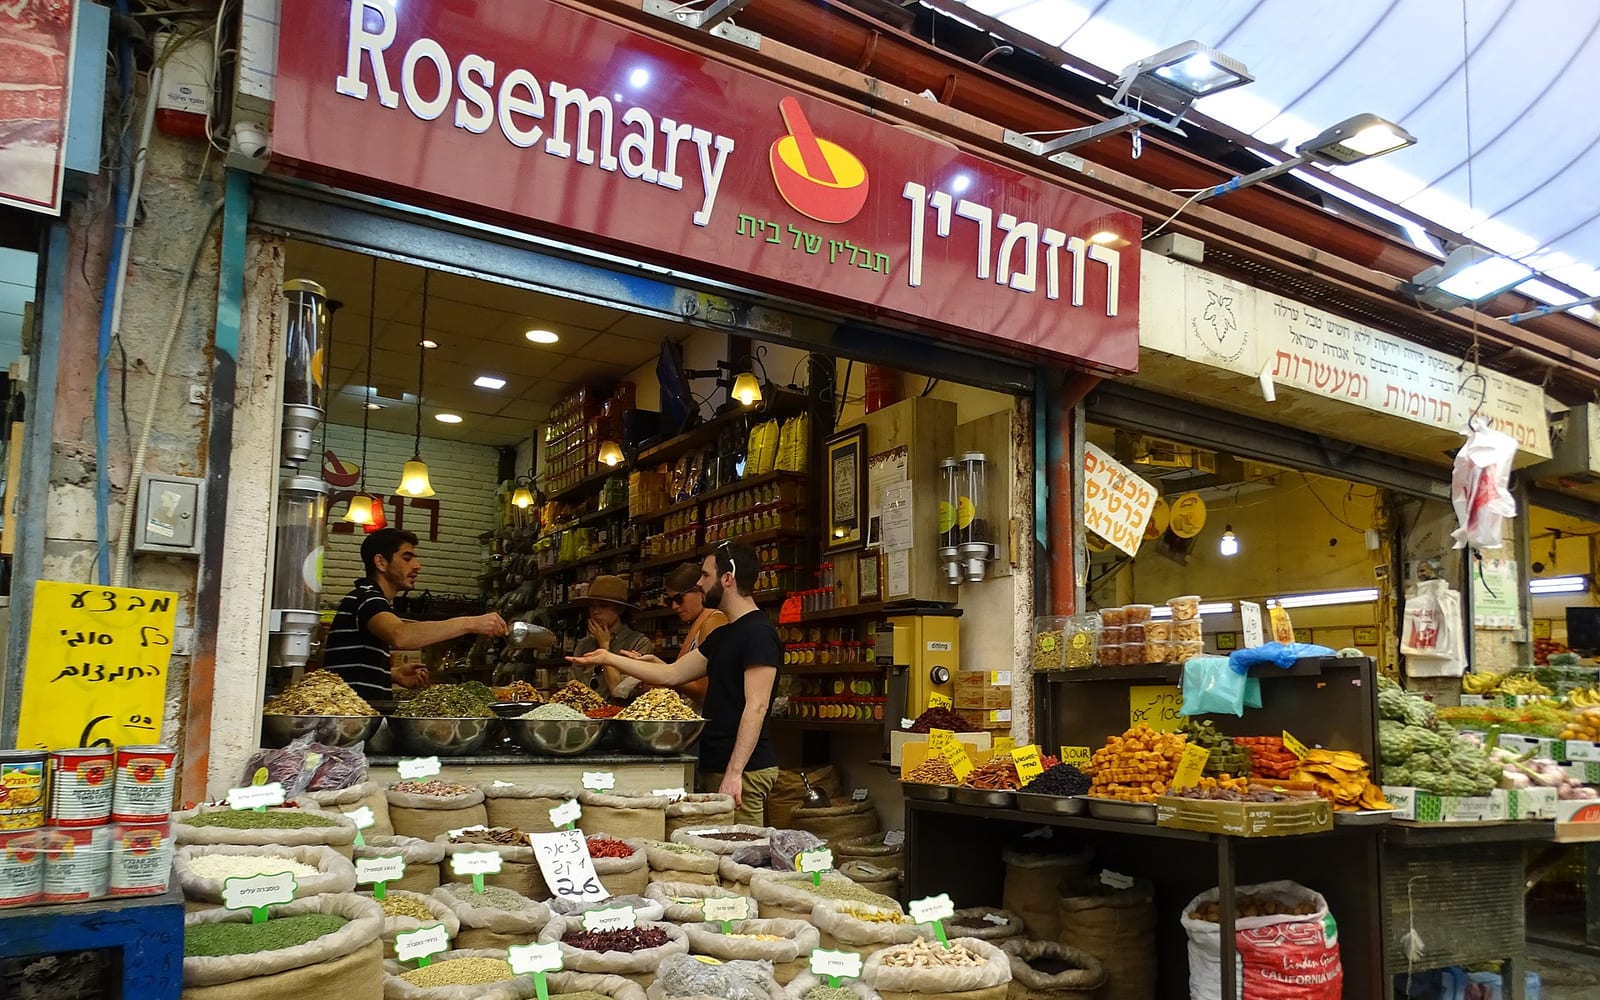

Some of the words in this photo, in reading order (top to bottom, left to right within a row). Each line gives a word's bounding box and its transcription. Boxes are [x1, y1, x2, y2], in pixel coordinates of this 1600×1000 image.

[335, 0, 734, 226] Rosemary
[736, 213, 781, 244] בית
[787, 223, 823, 255] של
[829, 240, 890, 275] תבלין
[902, 181, 1120, 317] רוזמרין
[1289, 325, 1318, 350] ישראל
[1272, 349, 1368, 403] ומעשרות
[1383, 383, 1452, 425] תרומות
[1084, 451, 1151, 510] מכבדים
[1084, 502, 1141, 553] אשראי
[69, 590, 171, 613] מבצע
[139, 626, 169, 647] כל
[1063, 748, 1090, 760] SOUR
[557, 877, 600, 895] 26
[1261, 969, 1326, 985] CALIFORNIA
